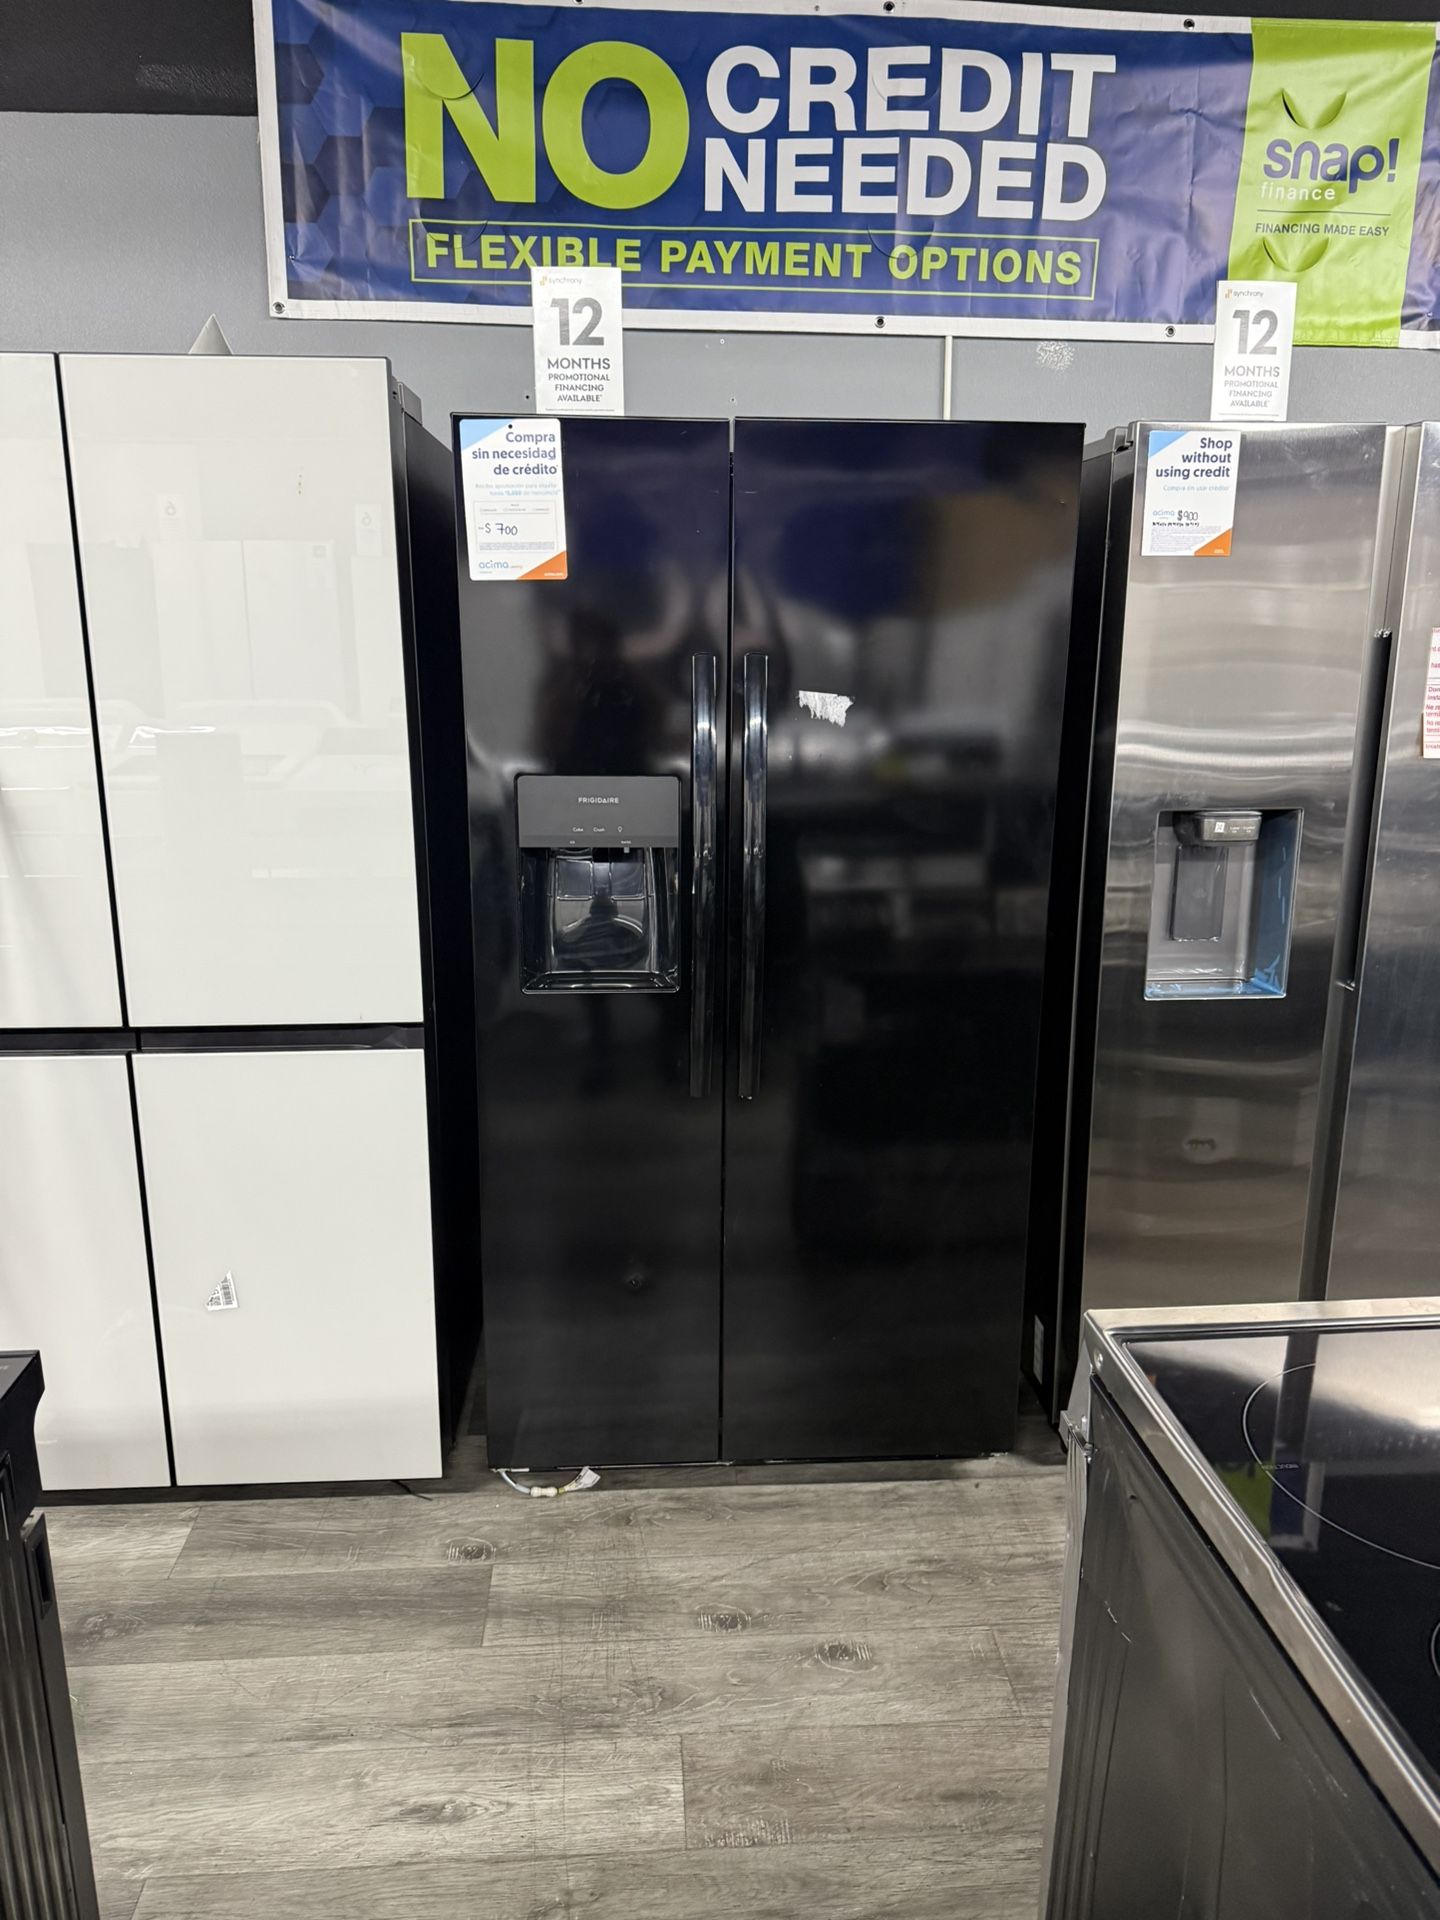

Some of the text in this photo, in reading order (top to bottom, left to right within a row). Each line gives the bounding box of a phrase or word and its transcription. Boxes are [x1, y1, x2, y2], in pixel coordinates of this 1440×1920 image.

[706, 45, 1117, 138] CREDIT
[401, 32, 690, 211] NO
[1263, 138, 1400, 194] snap!
[704, 136, 1107, 221] NEEDED
[1260, 181, 1336, 201] finance
[1255, 222, 1390, 237] FINANCING MADE EASY
[426, 233, 1082, 285] FLEXIBLE PAYMENT OPTIONS
[549, 276, 583, 285] synchrony
[1233, 289, 1264, 298] synchrony
[550, 297, 605, 346] 12
[1232, 309, 1278, 355] 12
[547, 358, 611, 370] MONTHS
[548, 373, 610, 382] PROMOTIONAL
[1224, 365, 1280, 378] MONTHS
[555, 384, 605, 392] FINANCING
[1224, 380, 1278, 389] PROMOTIONAL
[1229, 389, 1273, 398] FINANCING
[505, 432, 556, 446] Compra
[1200, 437, 1233, 452] Shop
[472, 447, 557, 461] sin necesidad
[1182, 452, 1232, 463] without
[493, 464, 510, 475] de
[1155, 465, 1230, 480] using credit
[495, 523, 518, 536] 700
[478, 560, 509, 569] acima
